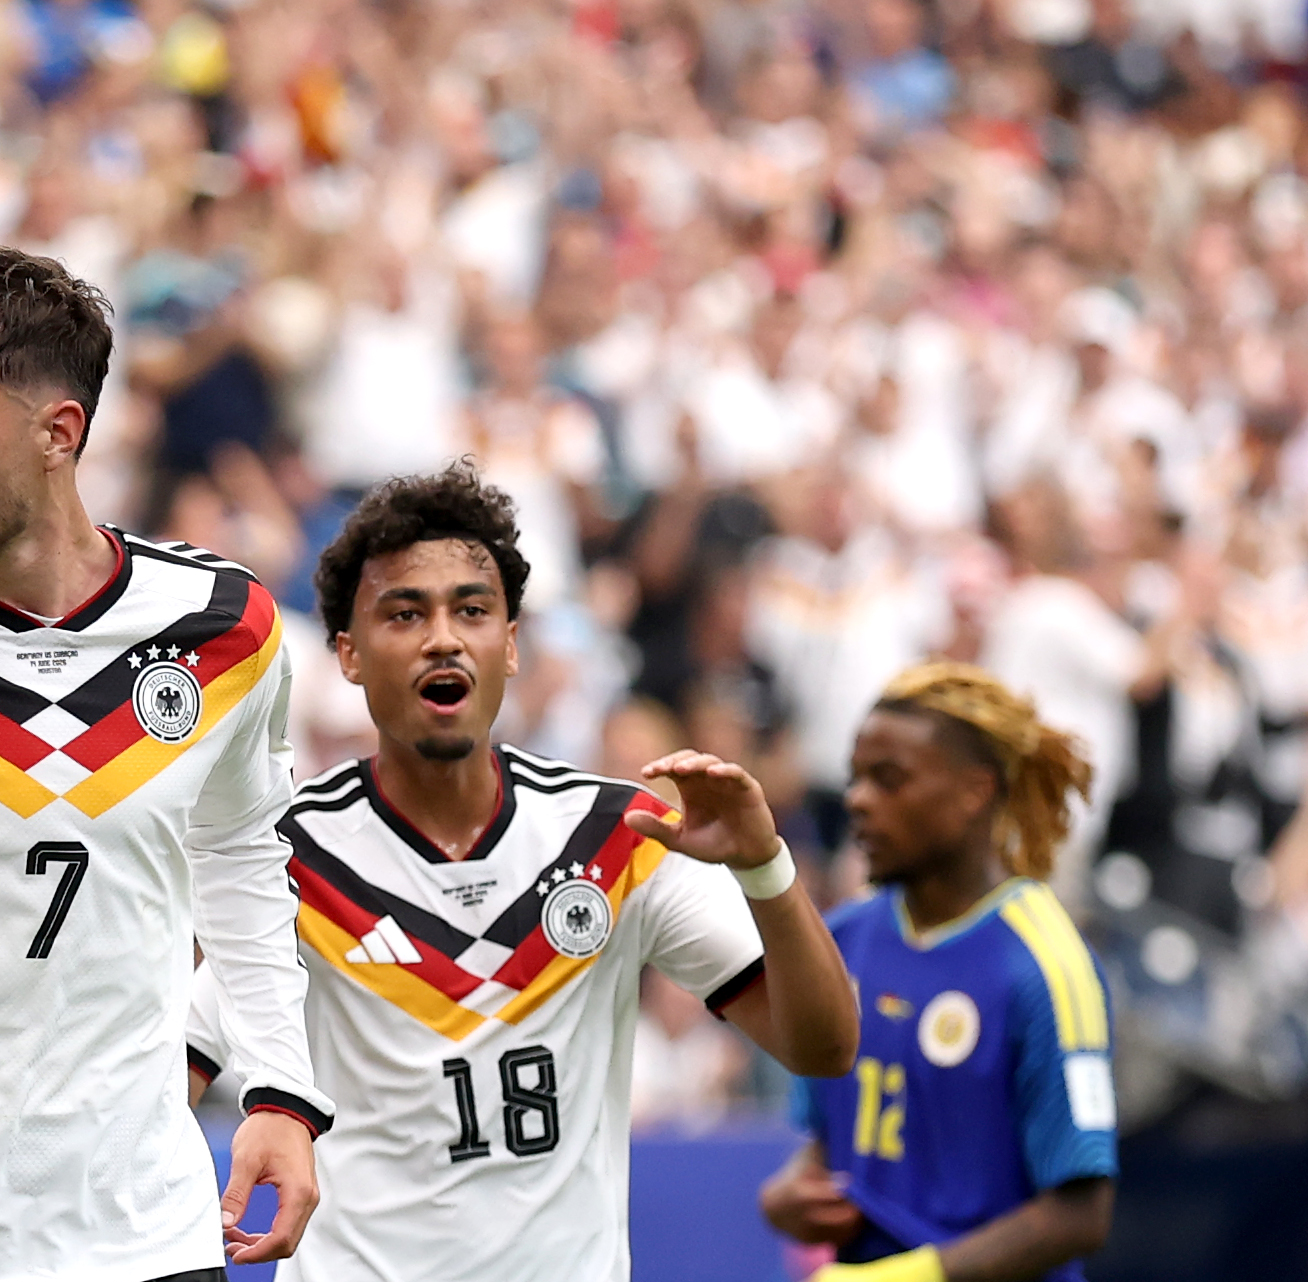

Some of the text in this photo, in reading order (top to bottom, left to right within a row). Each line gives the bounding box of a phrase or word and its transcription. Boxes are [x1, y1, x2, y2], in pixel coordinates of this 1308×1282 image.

[148, 674, 186, 689] DEUTSCHER
[26, 841, 88, 959] 7
[443, 1044, 560, 1163] 18
[854, 1057, 906, 1160] 12
